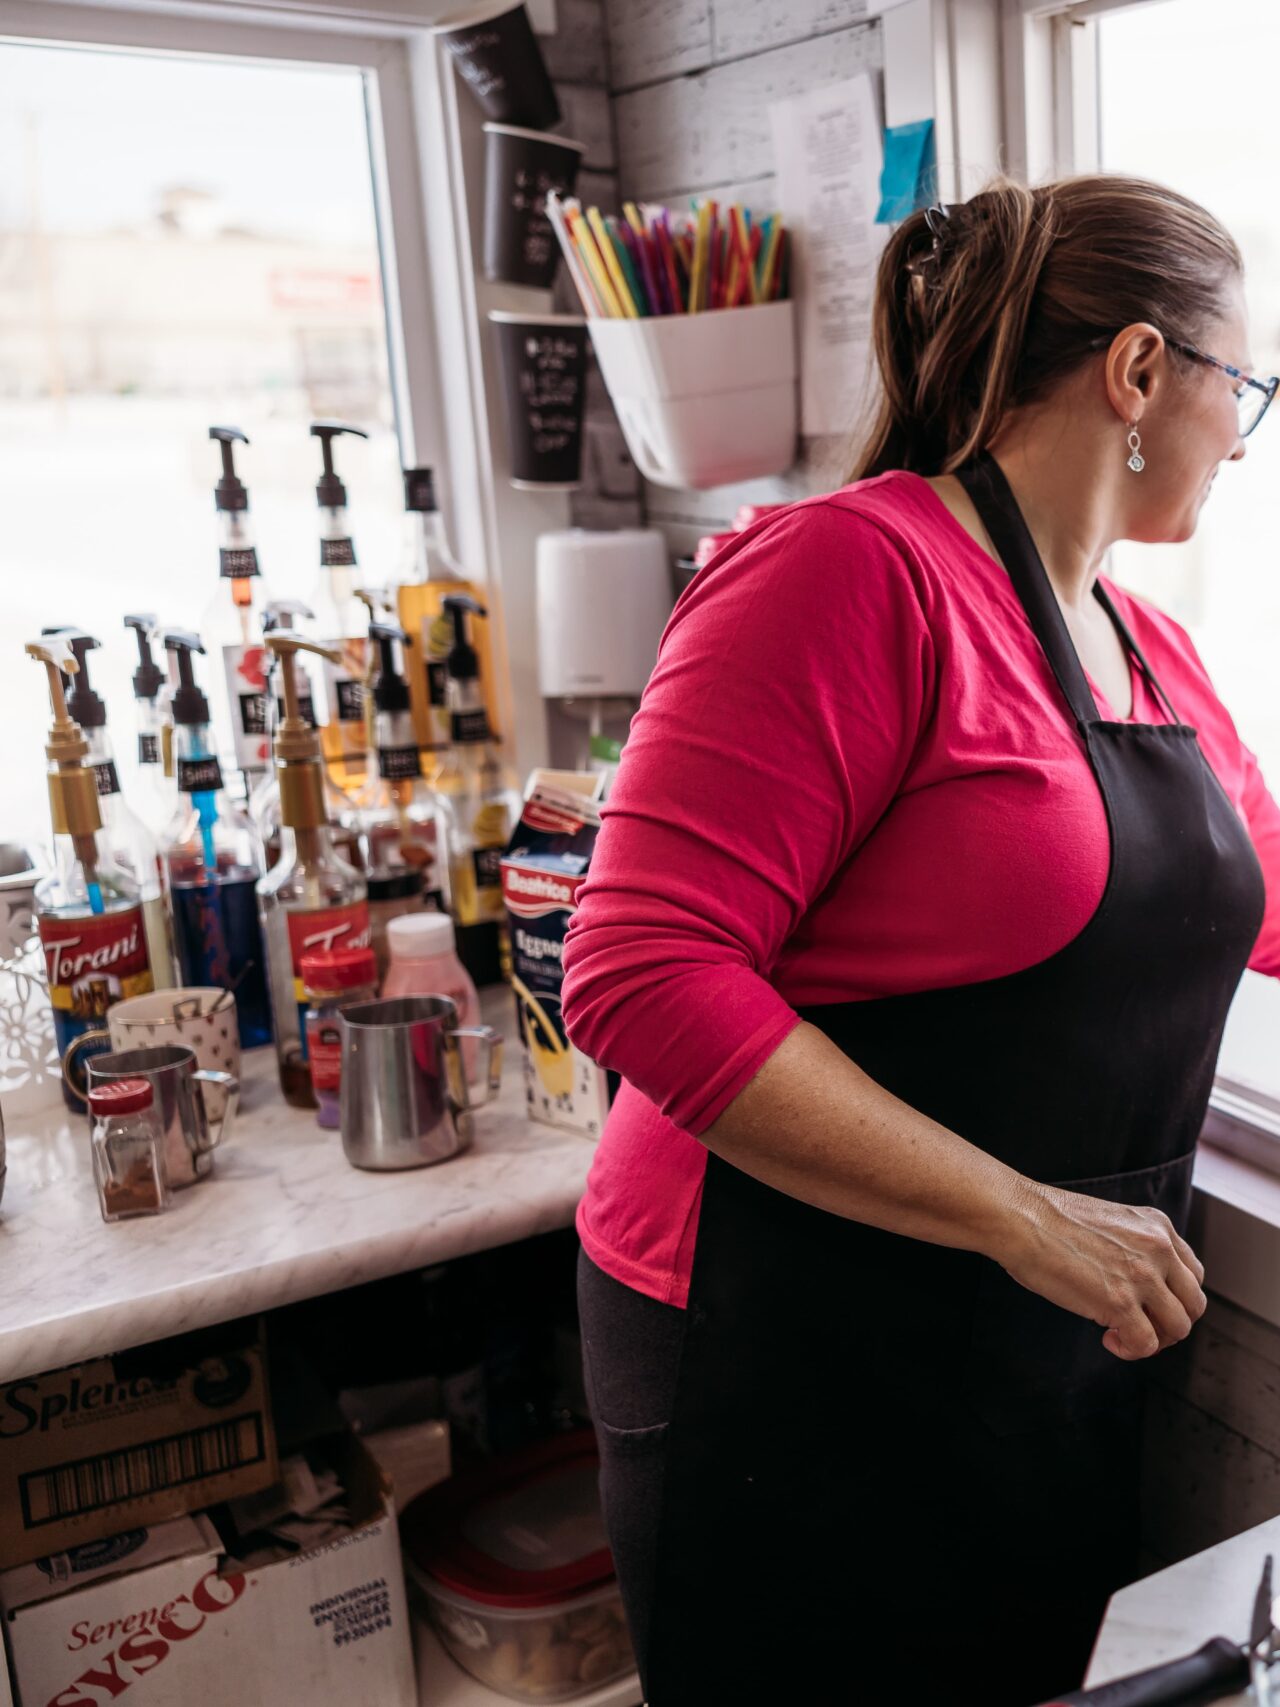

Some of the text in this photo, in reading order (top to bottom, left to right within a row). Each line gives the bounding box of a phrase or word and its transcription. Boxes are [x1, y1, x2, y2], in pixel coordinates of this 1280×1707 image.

[44, 924, 139, 985] Torani
[310, 1578, 386, 1615] INDIVIDUAL
[314, 1591, 388, 1628] ENVELOPES
[67, 1600, 179, 1651] Serene
